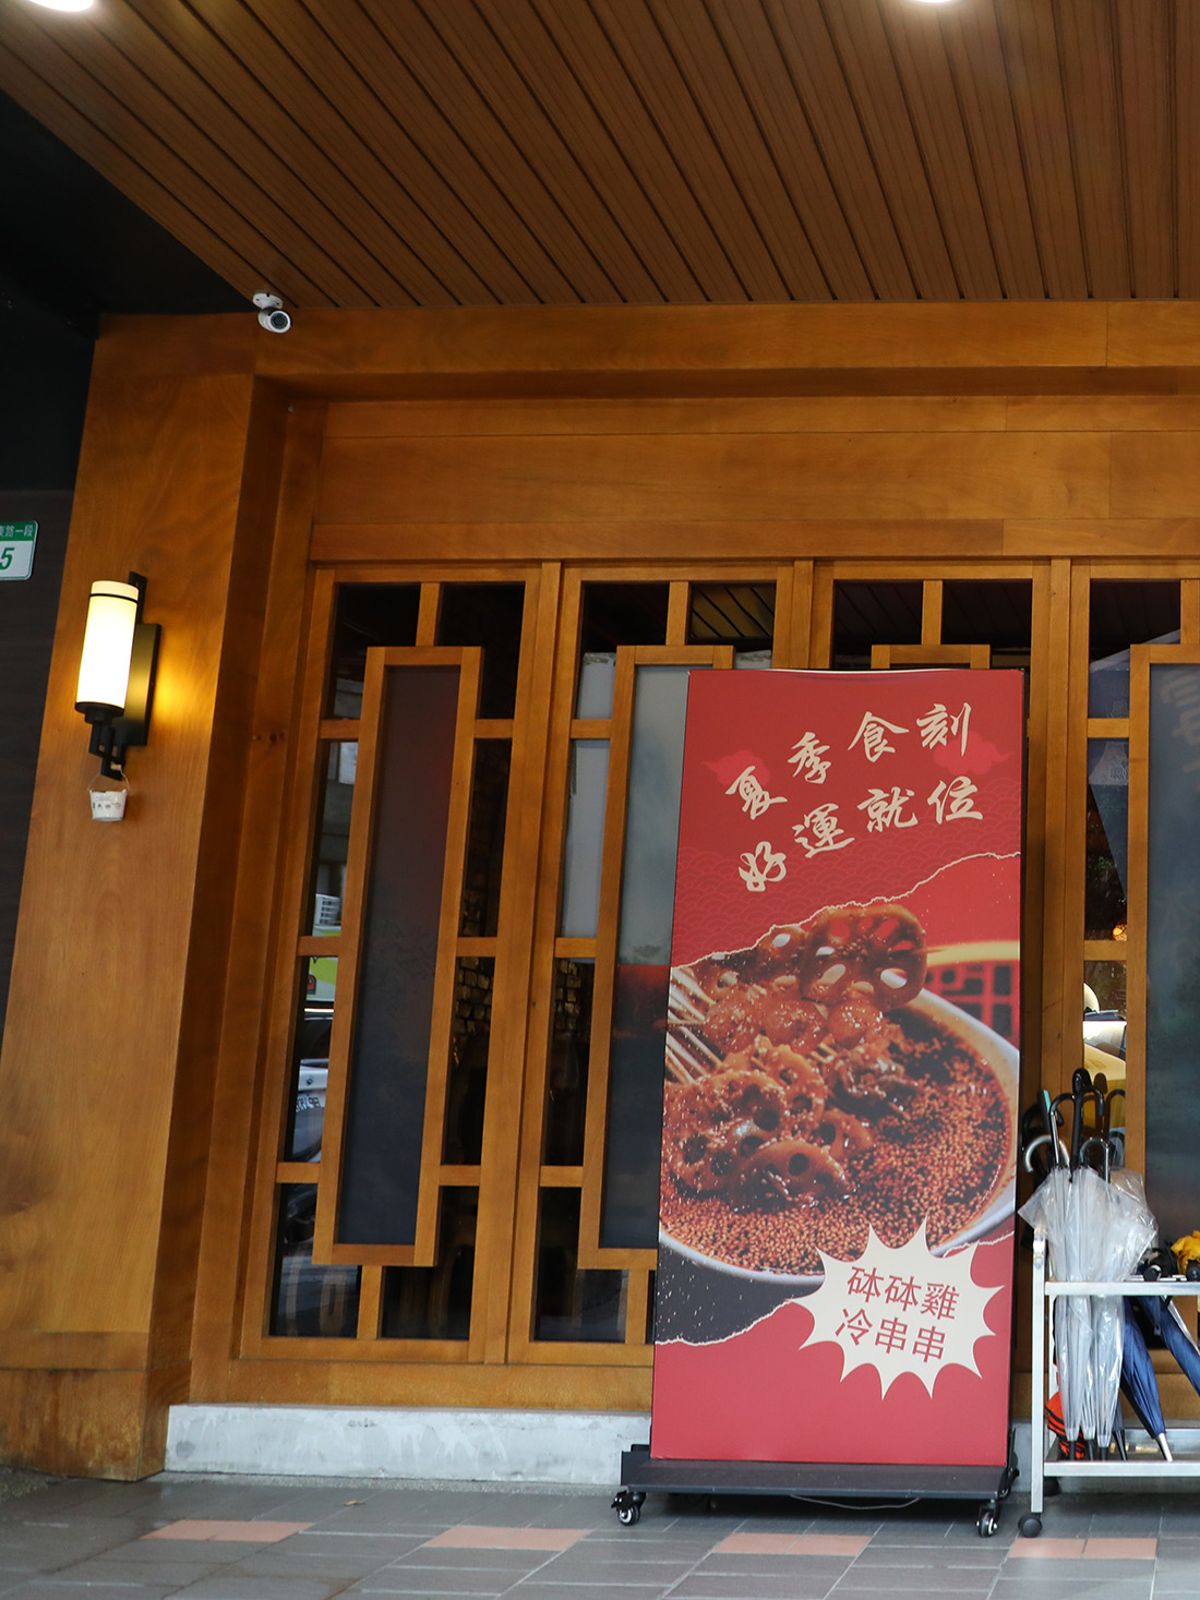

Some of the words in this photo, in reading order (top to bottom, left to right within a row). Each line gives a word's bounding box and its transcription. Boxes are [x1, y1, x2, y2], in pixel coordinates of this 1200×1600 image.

[725, 702, 973, 821] 夏季食刻
[738, 775, 984, 893] 好運就位
[834, 1308, 947, 1363] 冷串串
[847, 1266, 960, 1320] 砵砵雞
